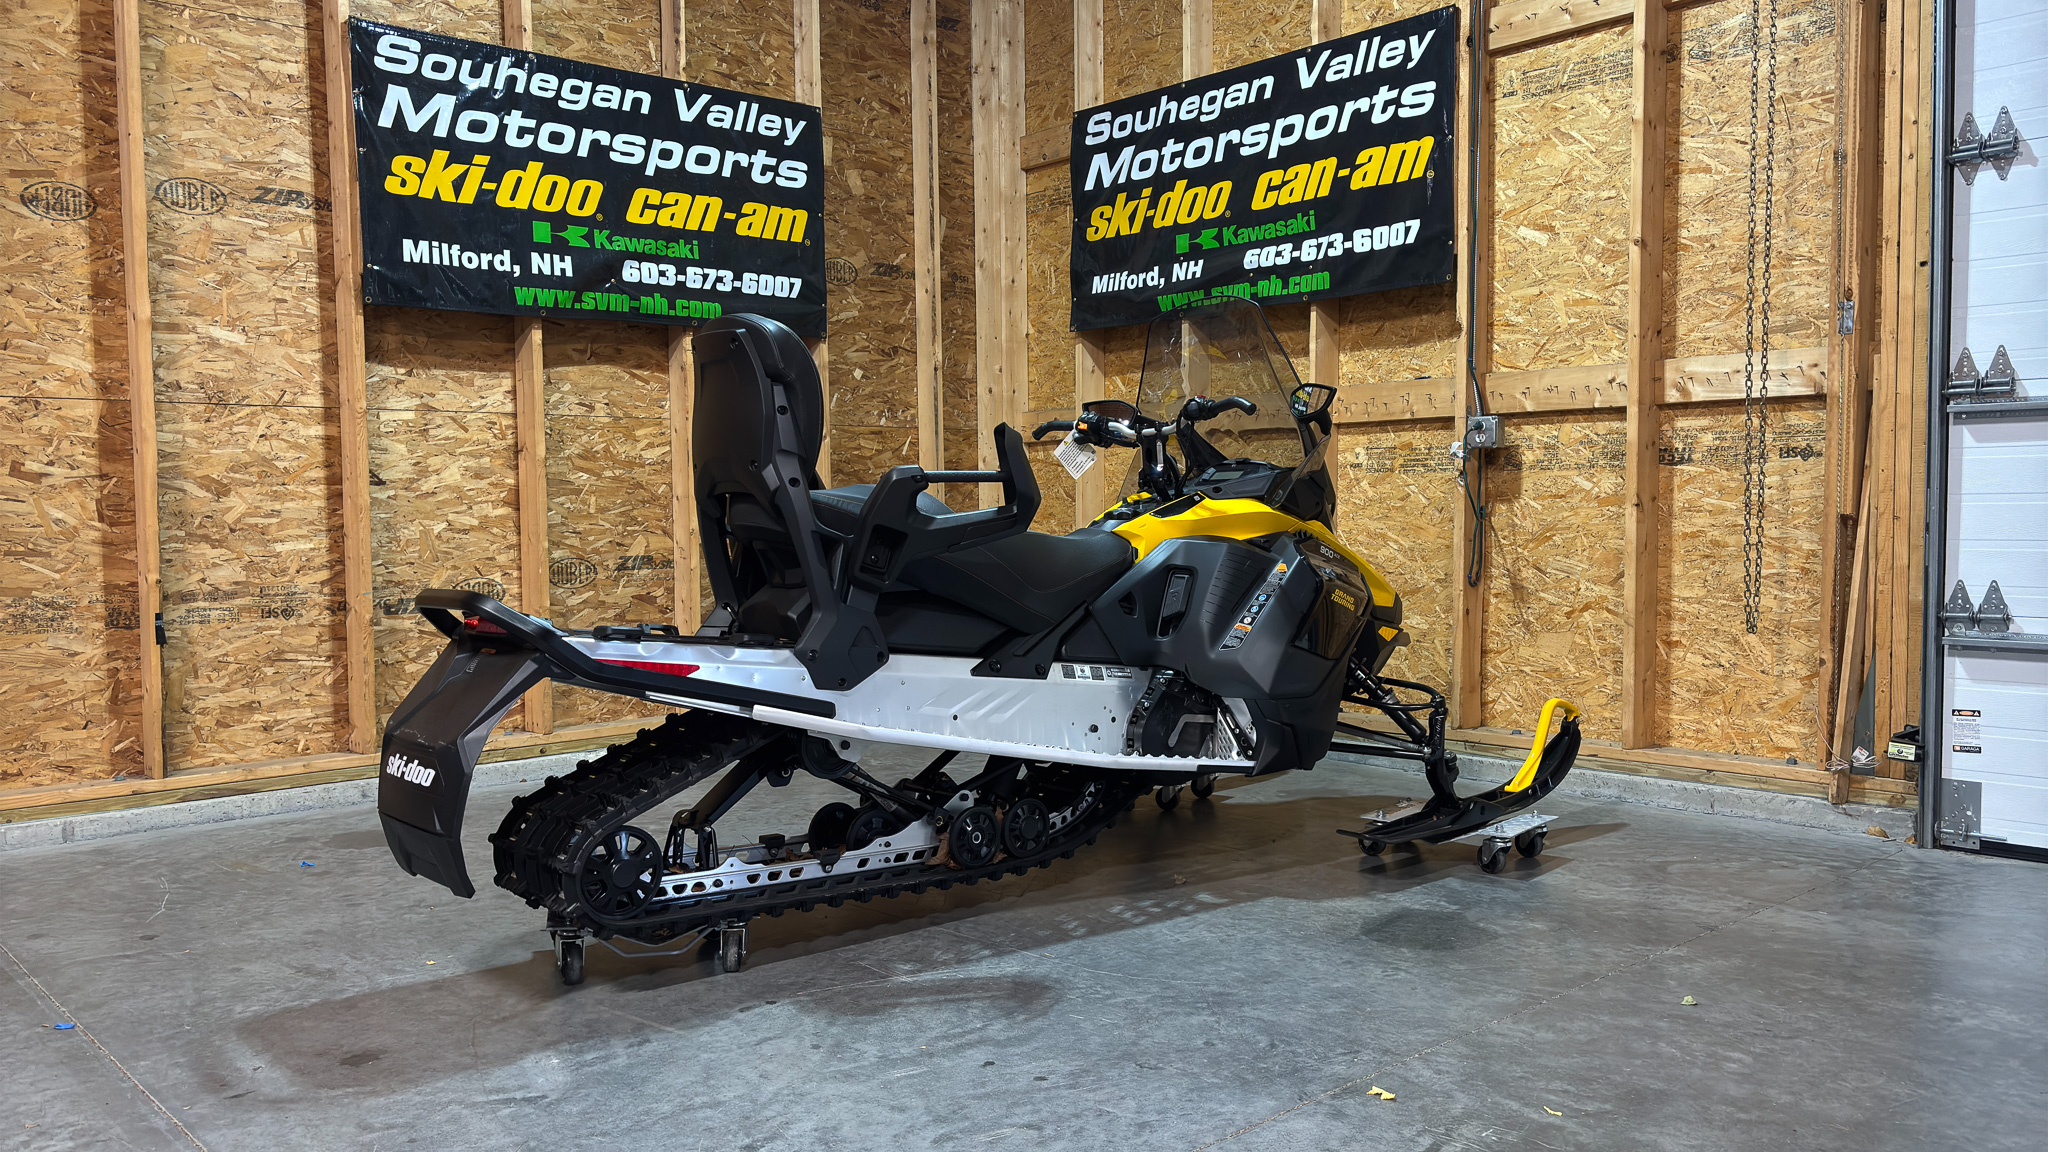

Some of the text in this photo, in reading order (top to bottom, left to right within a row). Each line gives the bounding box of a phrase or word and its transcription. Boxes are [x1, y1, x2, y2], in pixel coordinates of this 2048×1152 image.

[374, 34, 807, 145] Souhegan Valley
[1085, 75, 1274, 145] Souhegan
[1296, 29, 1436, 90] Valley
[378, 84, 808, 188] Motorsports
[1084, 80, 1436, 191] Motorsports
[384, 149, 808, 242] ski-doo can-am
[1086, 180, 1232, 242] ski-doo
[1251, 136, 1434, 211] can-am
[594, 229, 699, 260] Kawasaki
[1222, 210, 1316, 246] Kawasaki
[1244, 219, 1420, 270] 603-673-6007
[402, 239, 574, 277] Milford, NH
[1092, 258, 1204, 294] Milford, NH
[622, 260, 802, 298] 603-673-6007
[1157, 270, 1330, 312] www.svm-nh.com
[514, 286, 722, 319] www.svm-nh.com
[1320, 546, 1334, 558] 900
[1331, 594, 1355, 611] TOURING
[1334, 588, 1354, 604] GRAND
[386, 754, 436, 788] ski-doo
